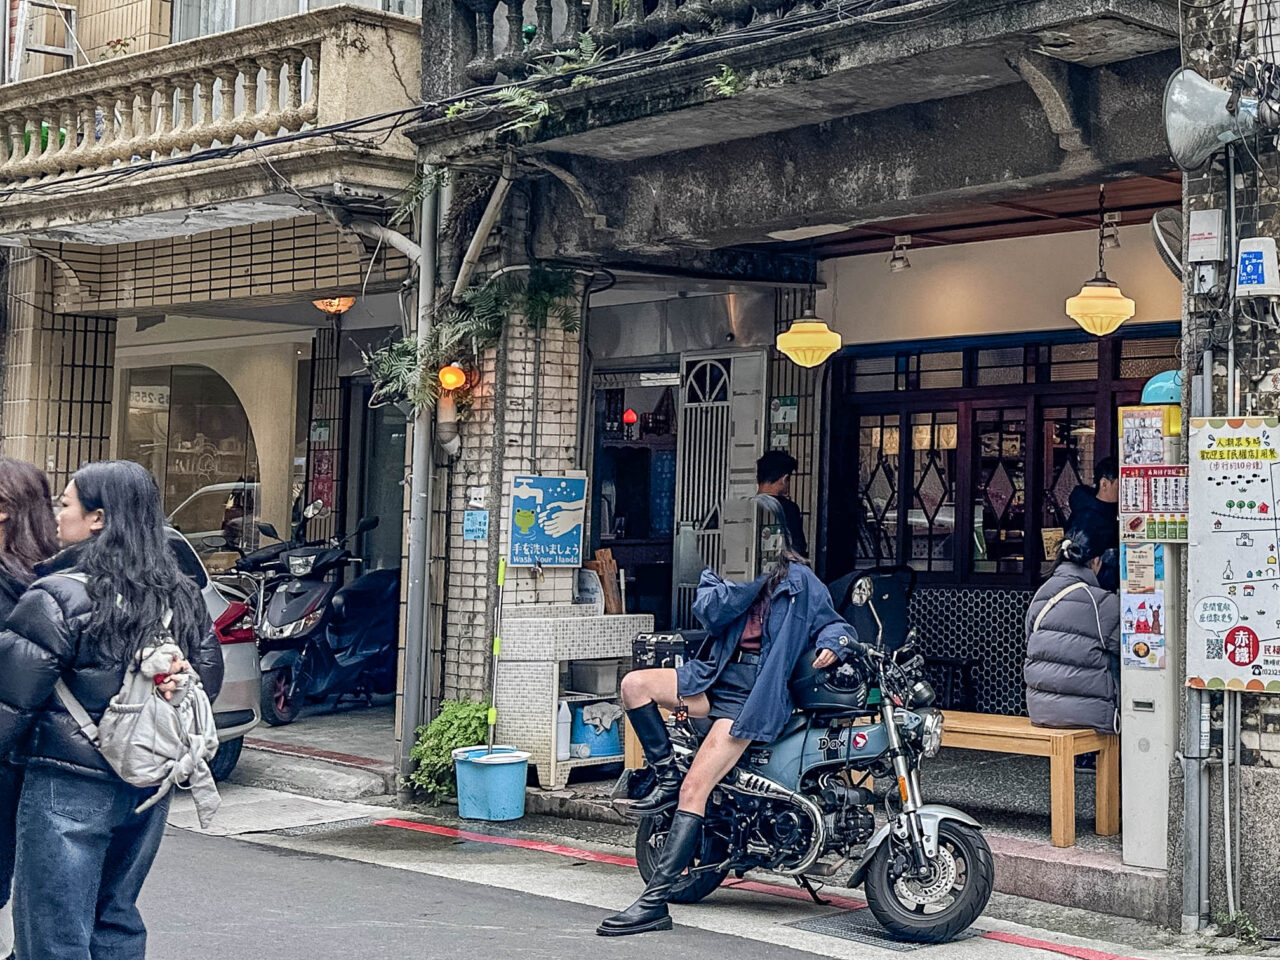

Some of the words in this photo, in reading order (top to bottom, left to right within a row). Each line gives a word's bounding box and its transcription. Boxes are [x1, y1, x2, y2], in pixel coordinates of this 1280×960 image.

[512, 542, 579, 555] 手を洗いましょう
[513, 555, 532, 563] Wash
[535, 555, 553, 563] Your
[555, 555, 578, 563] Hands
[817, 737, 847, 751] Dax
